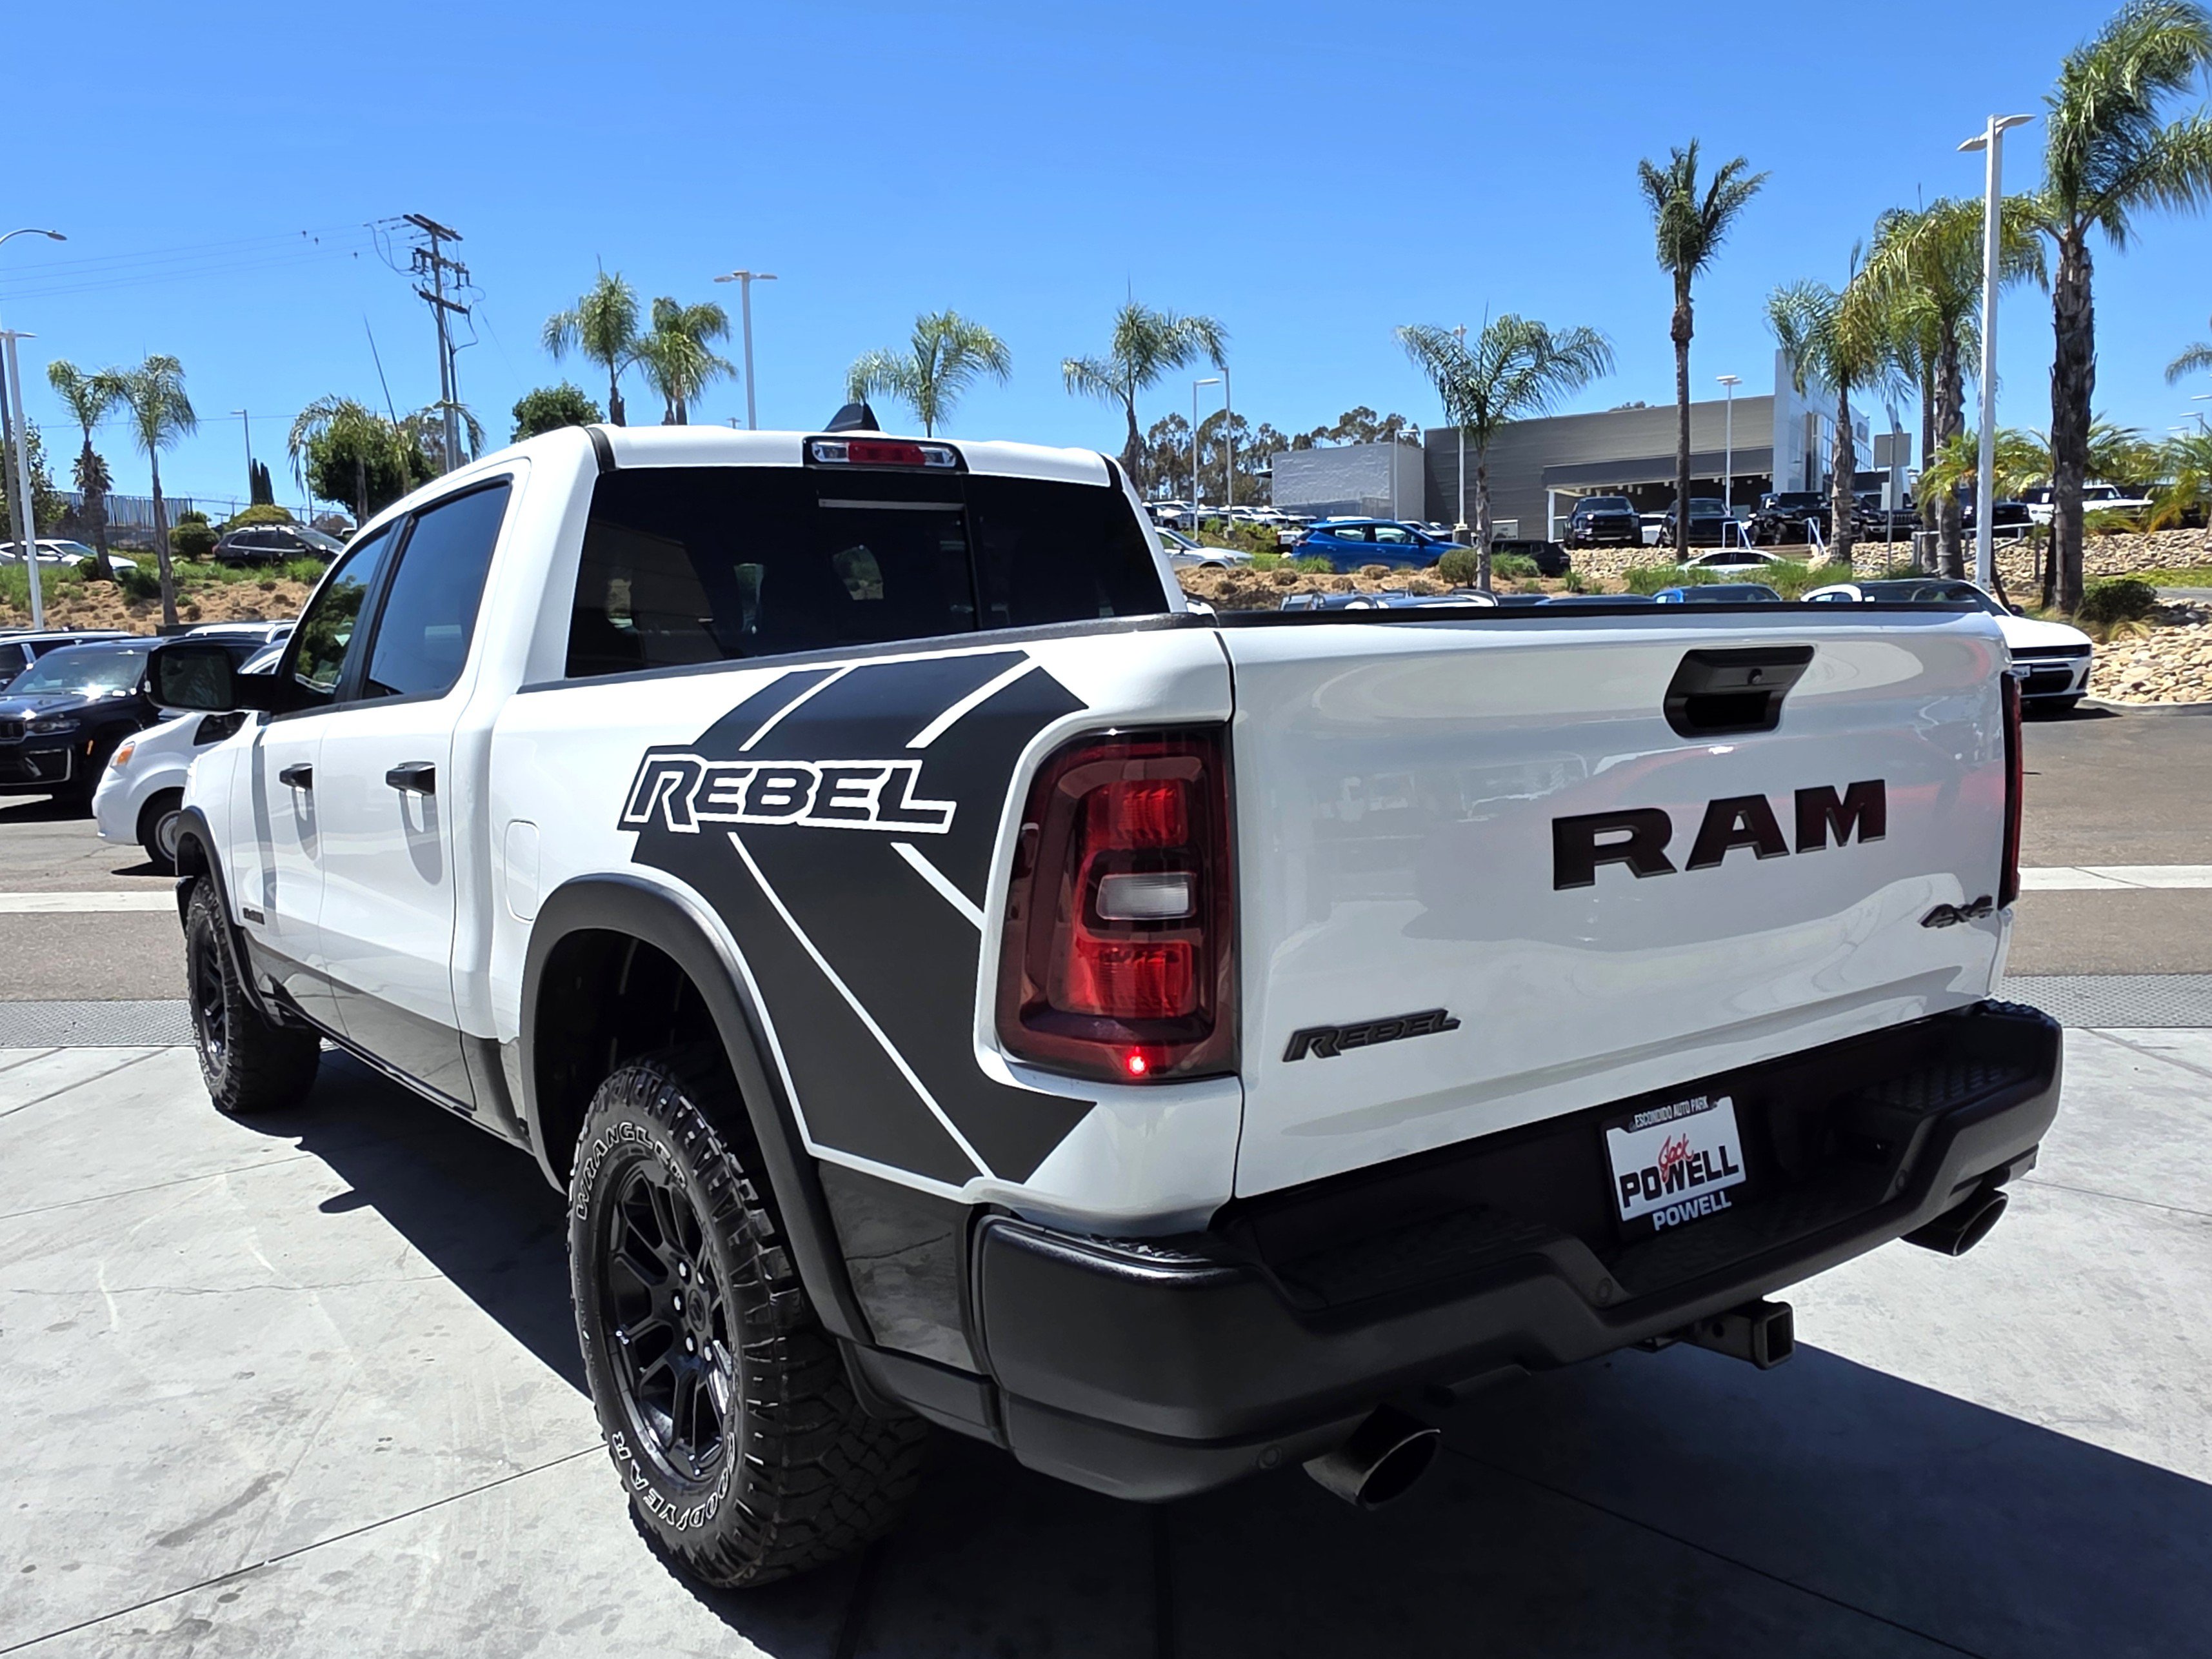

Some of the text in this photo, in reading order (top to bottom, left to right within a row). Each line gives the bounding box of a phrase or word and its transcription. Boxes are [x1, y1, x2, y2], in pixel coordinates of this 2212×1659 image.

[624, 753, 957, 834] REBEL
[1551, 778, 1886, 891] RAM
[1282, 1007, 1462, 1063] REBEL
[1633, 1095, 1709, 1128] ESCONDIDO AUTO PARK
[576, 1121, 688, 1222] WRANGLER
[1619, 1145, 1740, 1209] POWELL
[1658, 1132, 1695, 1184] Jack
[1652, 1191, 1732, 1231] POWELL
[612, 1431, 736, 1531] GOODYEAR
